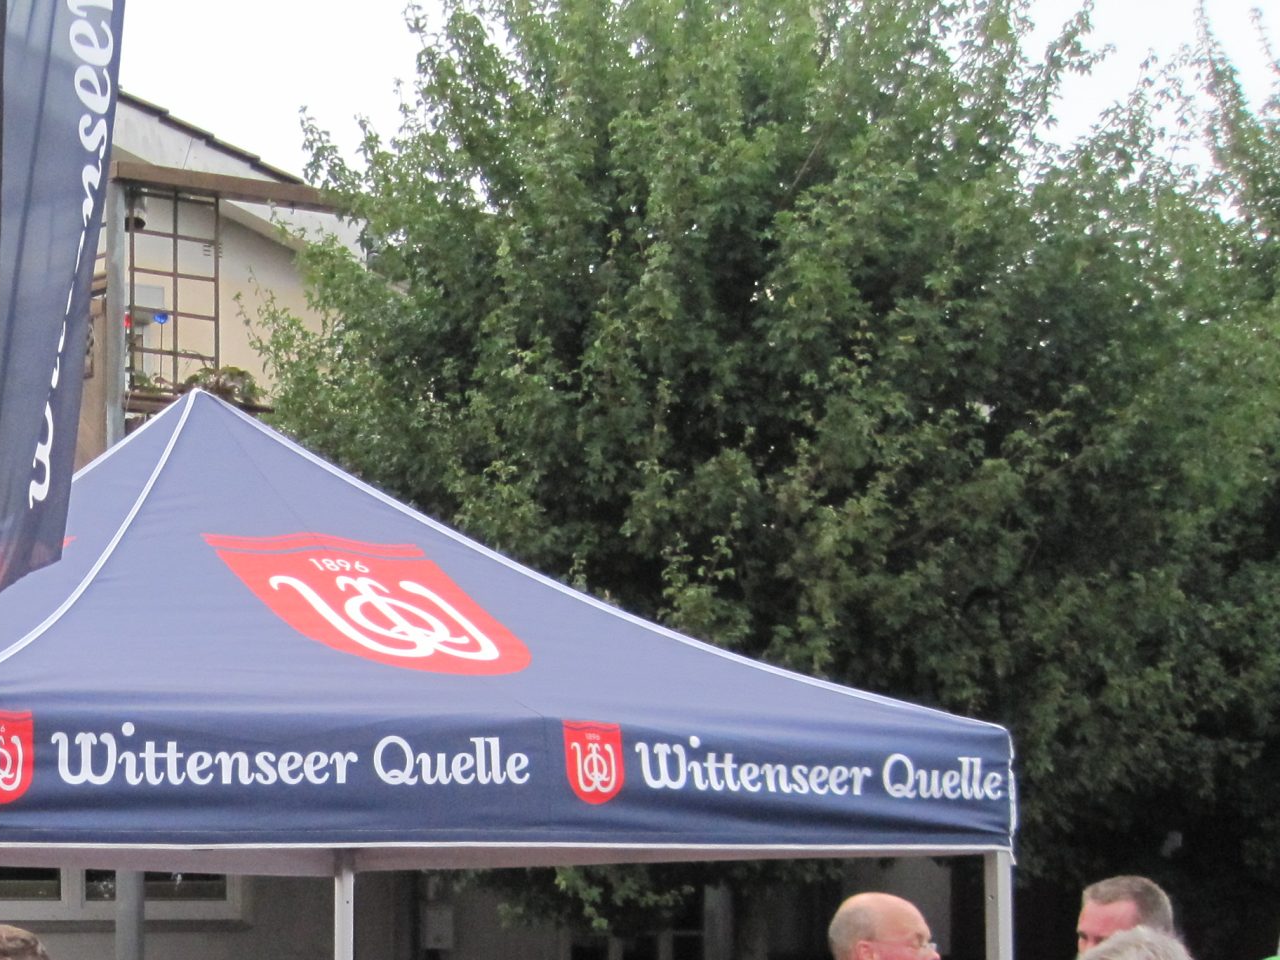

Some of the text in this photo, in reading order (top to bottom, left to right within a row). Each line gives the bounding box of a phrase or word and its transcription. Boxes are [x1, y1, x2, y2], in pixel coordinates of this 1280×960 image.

[308, 558, 370, 573] 1896
[51, 721, 531, 786] Wittenseer Quelle
[635, 735, 1003, 800] Wittenseer Quelle
